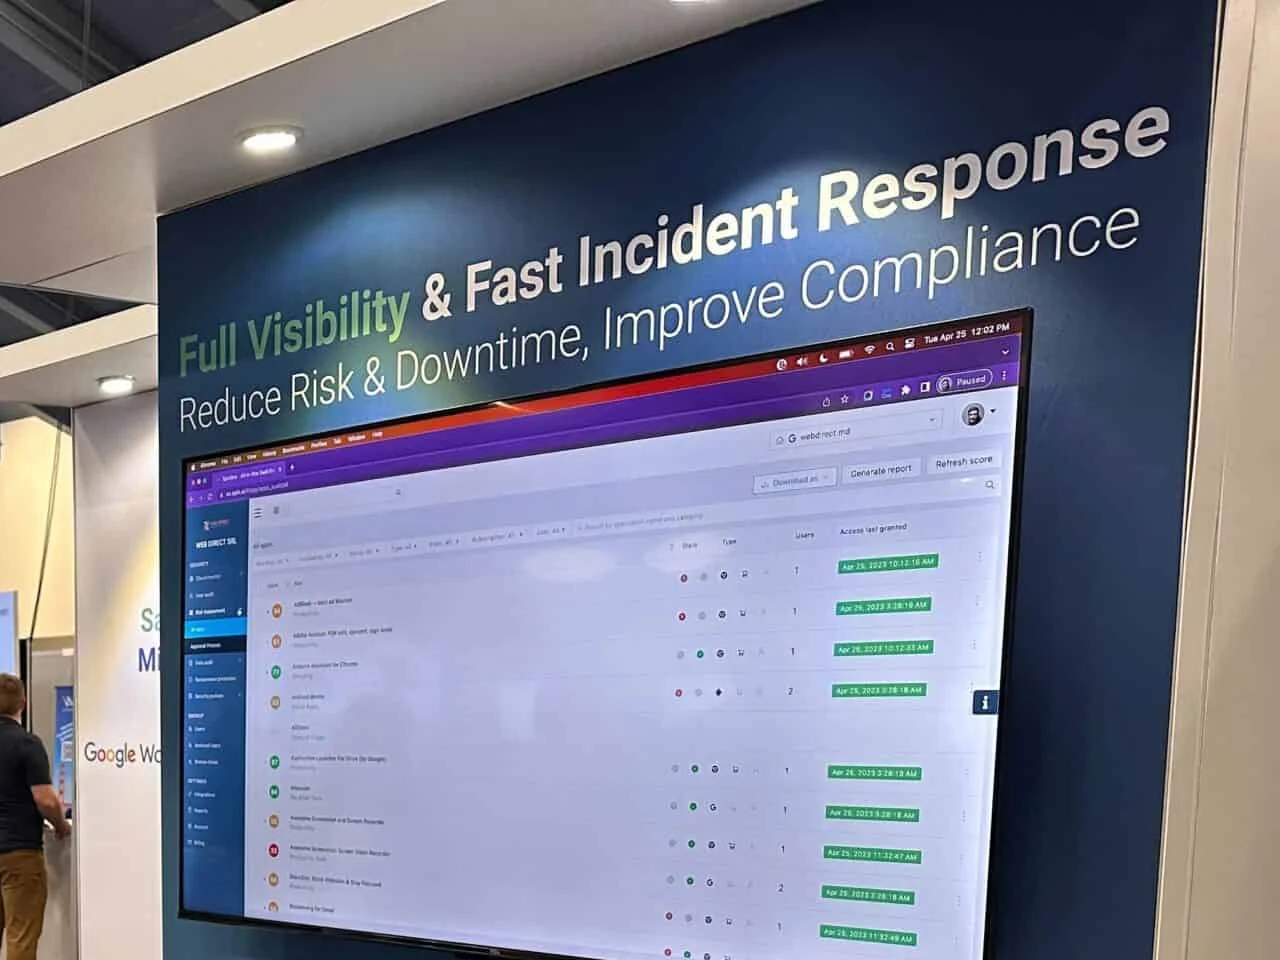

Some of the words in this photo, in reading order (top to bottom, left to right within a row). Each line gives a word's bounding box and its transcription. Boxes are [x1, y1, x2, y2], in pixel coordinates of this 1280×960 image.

[179, 322, 237, 378] Full
[248, 288, 411, 360] Visibility
[422, 272, 452, 321] &
[466, 247, 563, 312] Fast
[579, 187, 799, 287] Incident
[818, 106, 1170, 232] Response
[179, 387, 281, 432] Reduce
[291, 362, 355, 410] Risk
[364, 356, 385, 397] &
[396, 324, 589, 391] Downtime,
[605, 280, 785, 351] Improve
[801, 207, 1140, 309] Compliance
[924, 335, 938, 345] Tue
[940, 332, 954, 344] Apr
[972, 325, 996, 336] 12:02
[998, 322, 1010, 332] PM
[851, 467, 886, 478] Generate
[887, 464, 912, 475] report
[936, 457, 967, 468] Refresh
[970, 455, 993, 464] score
[84, 742, 136, 768] Google
